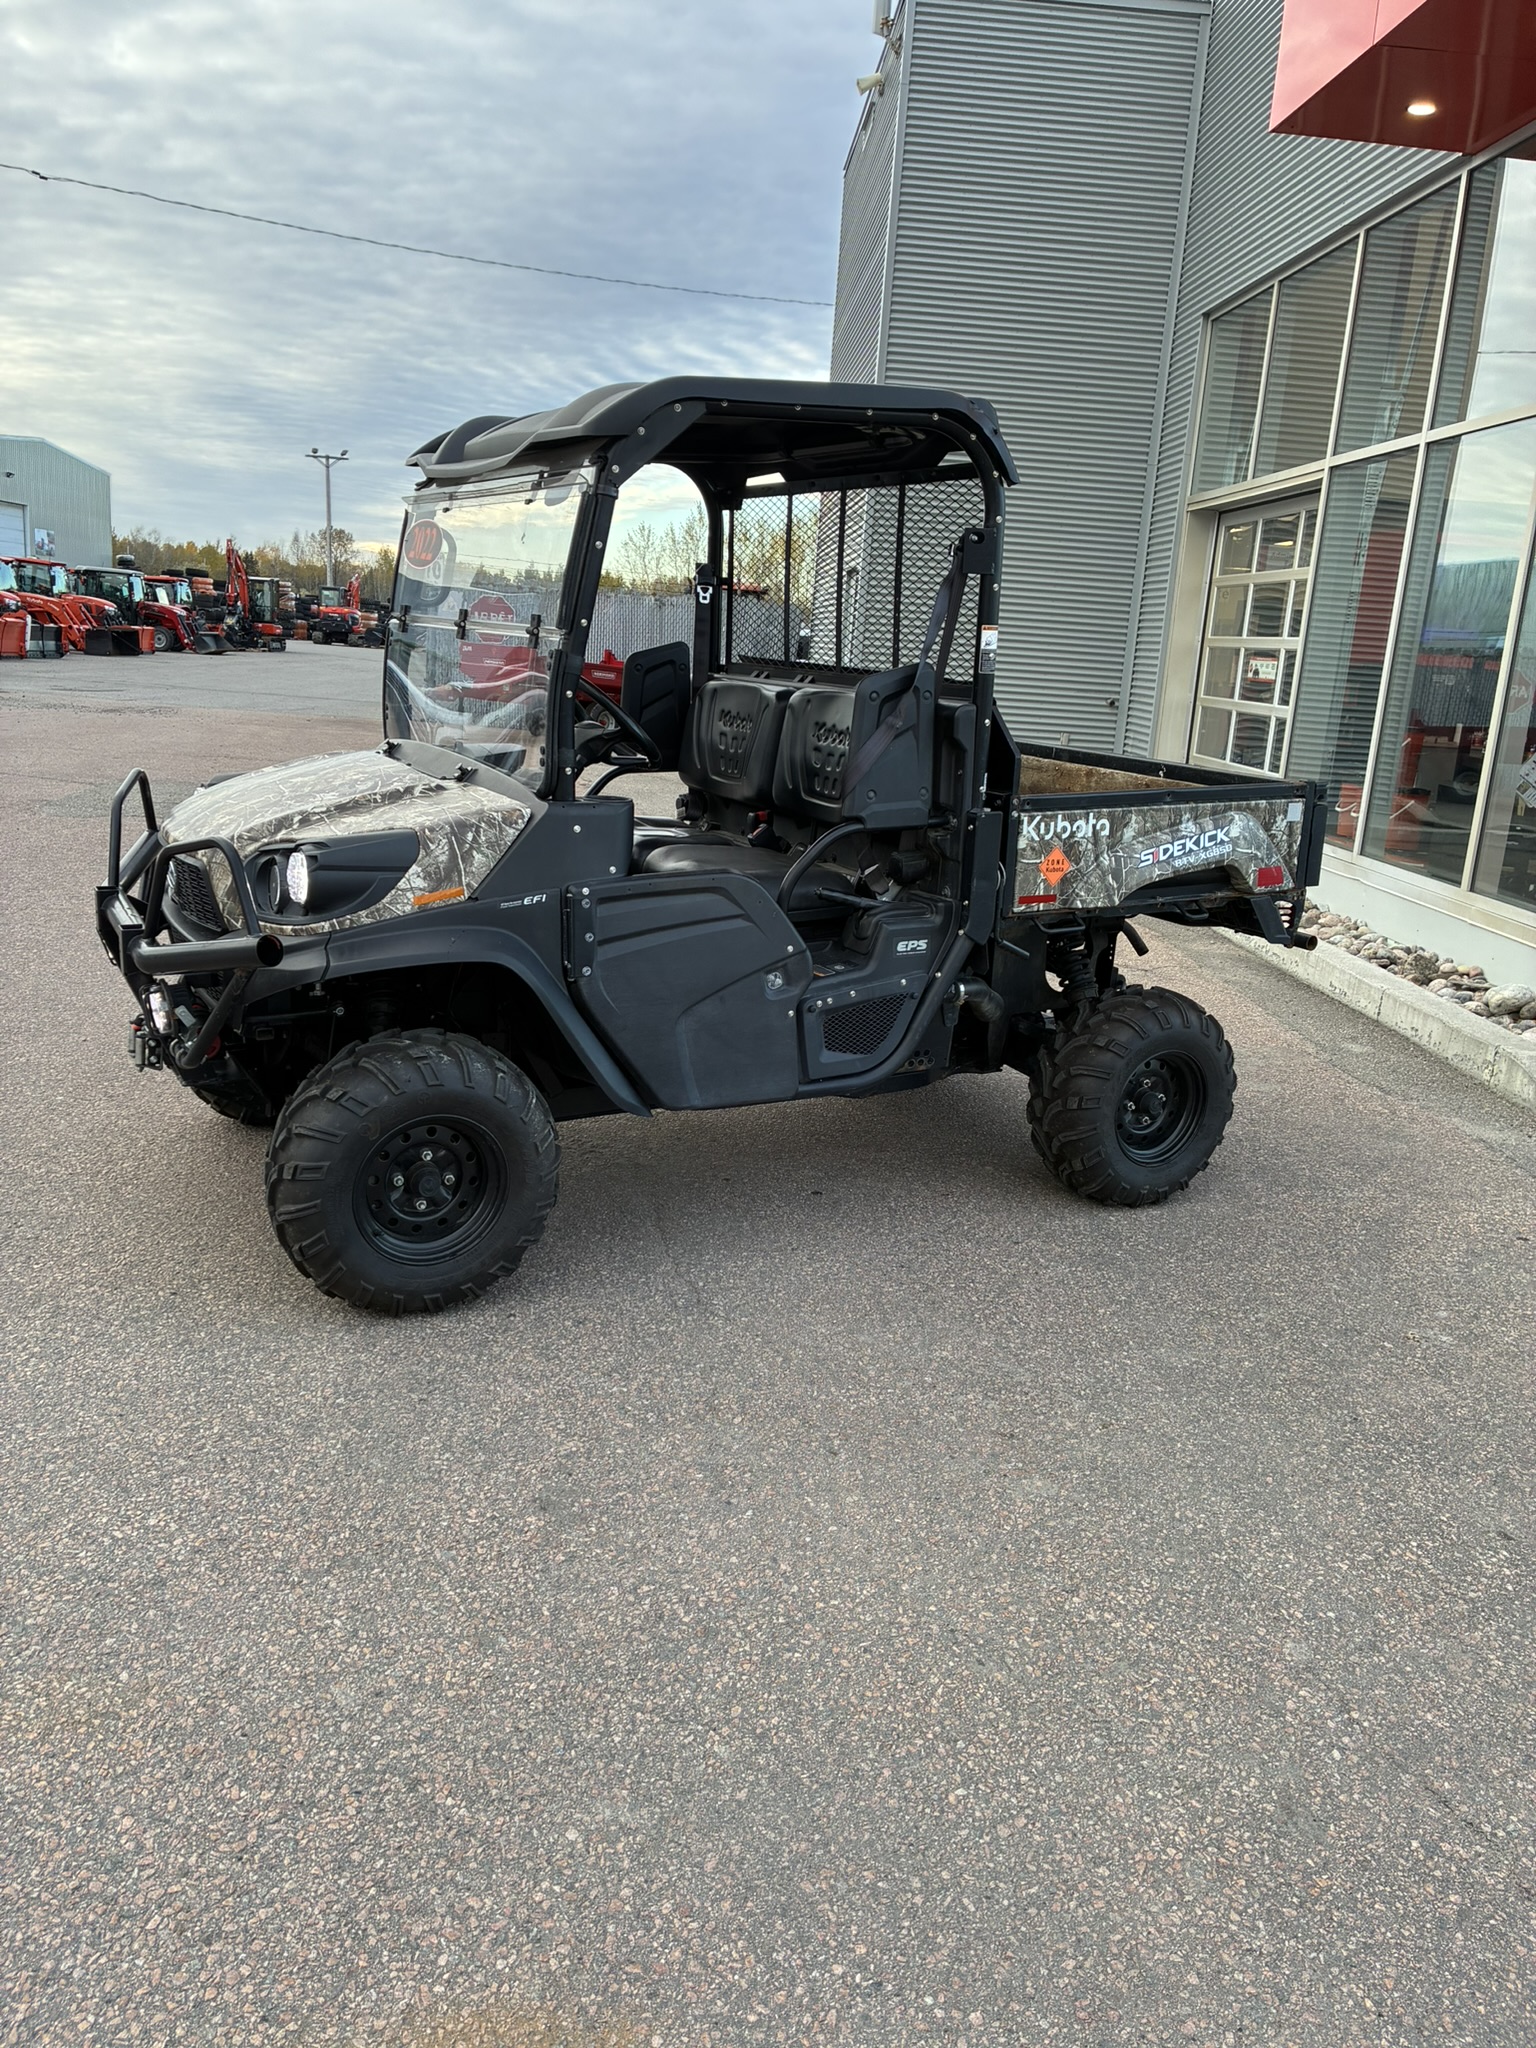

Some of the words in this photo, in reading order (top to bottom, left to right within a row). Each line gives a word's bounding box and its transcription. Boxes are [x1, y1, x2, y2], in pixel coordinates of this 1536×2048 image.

[408, 526, 437, 560] 2022
[1023, 812, 1110, 840] Kubota
[1138, 825, 1231, 868] SIDEKICK
[1046, 858, 1065, 866] ZONE
[523, 893, 547, 905] EFI
[896, 939, 929, 952] EPS
